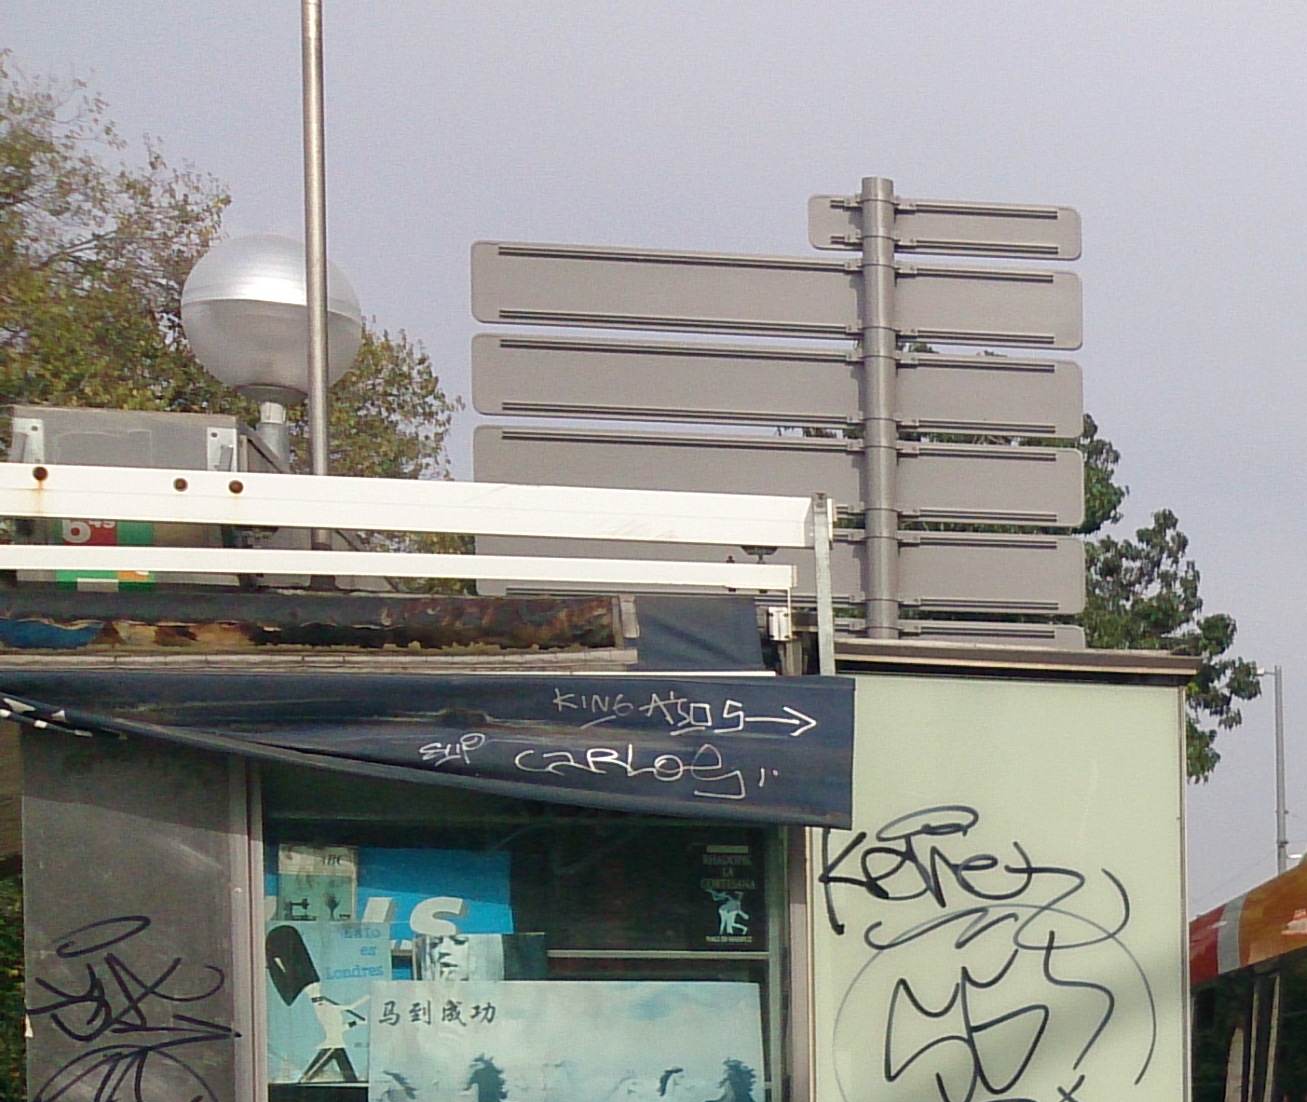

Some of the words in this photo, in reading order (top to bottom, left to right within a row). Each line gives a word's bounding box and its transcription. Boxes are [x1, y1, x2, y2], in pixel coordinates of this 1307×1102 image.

[324, 964, 384, 981] Londres
[378, 1000, 497, 1028] 马到成功
